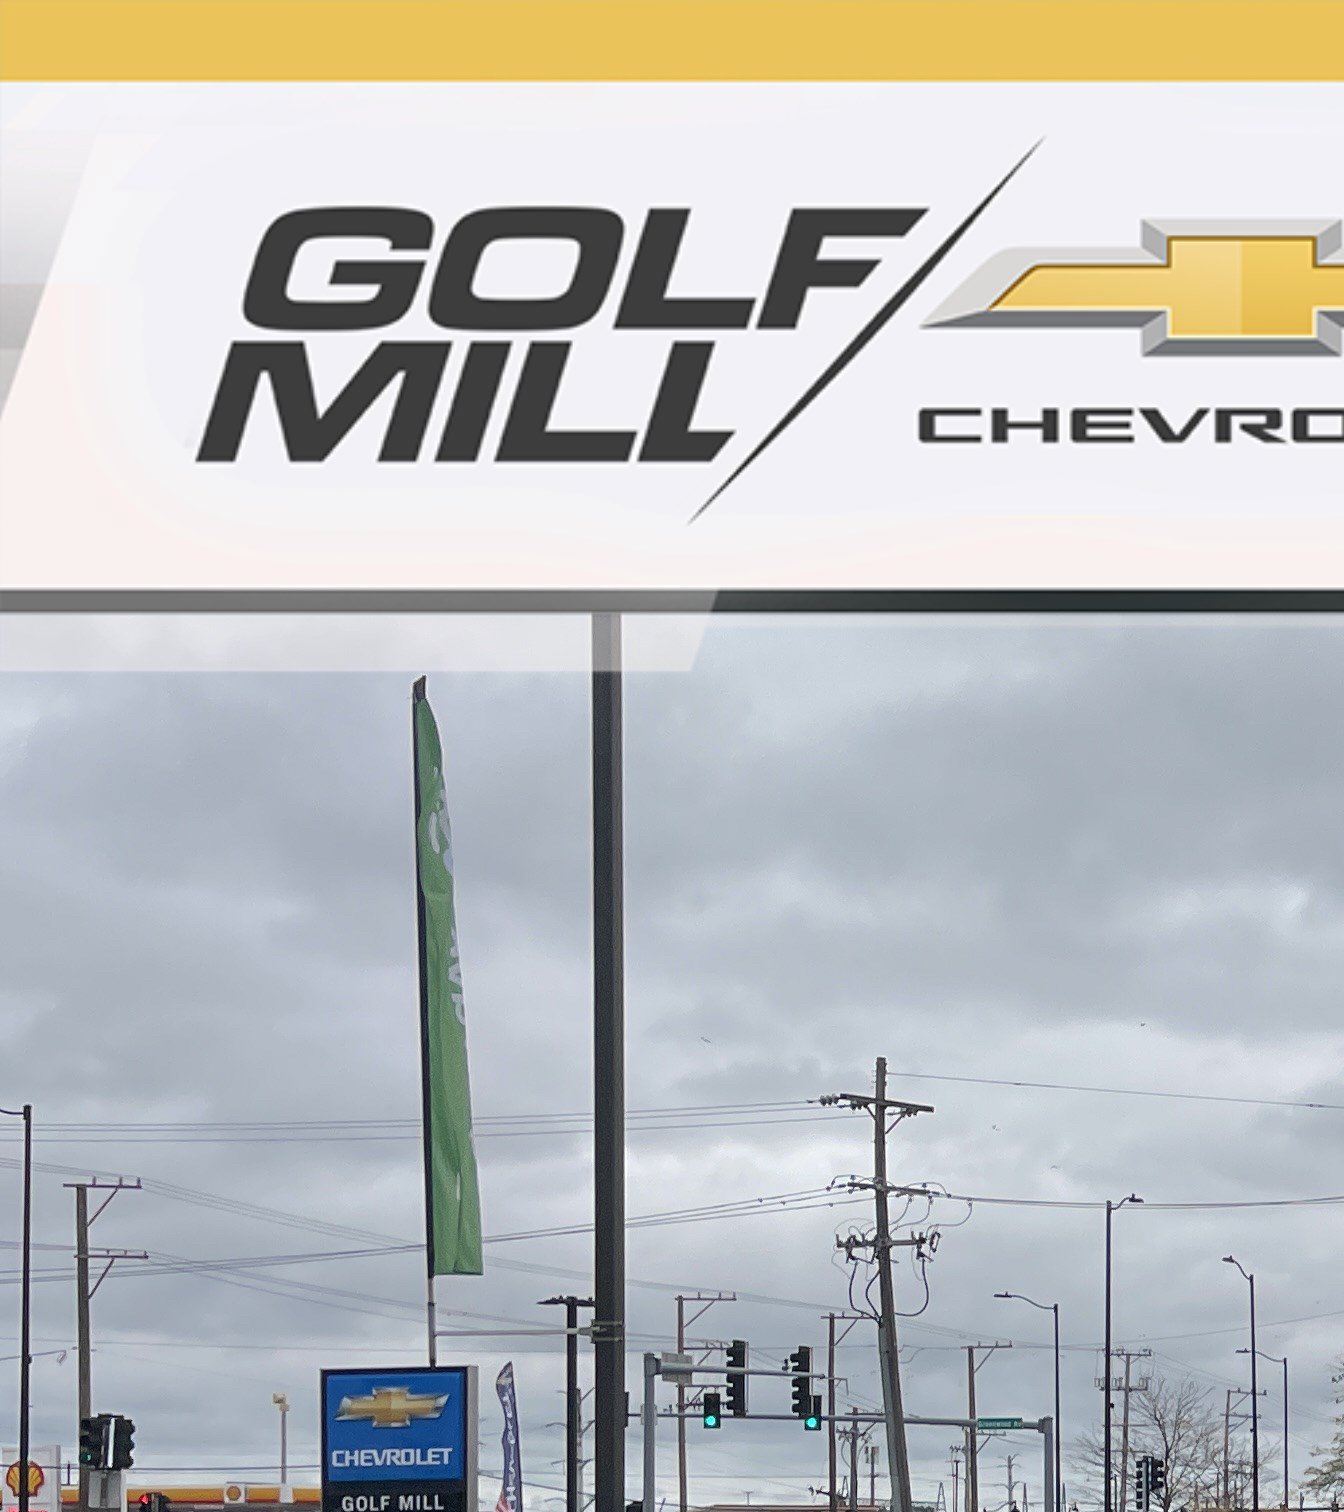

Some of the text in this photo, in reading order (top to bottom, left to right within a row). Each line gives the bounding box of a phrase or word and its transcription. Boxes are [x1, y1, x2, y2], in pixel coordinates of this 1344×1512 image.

[332, 1447, 454, 1468] CHEVROLET
[341, 1494, 445, 1512] GOLF MILL
